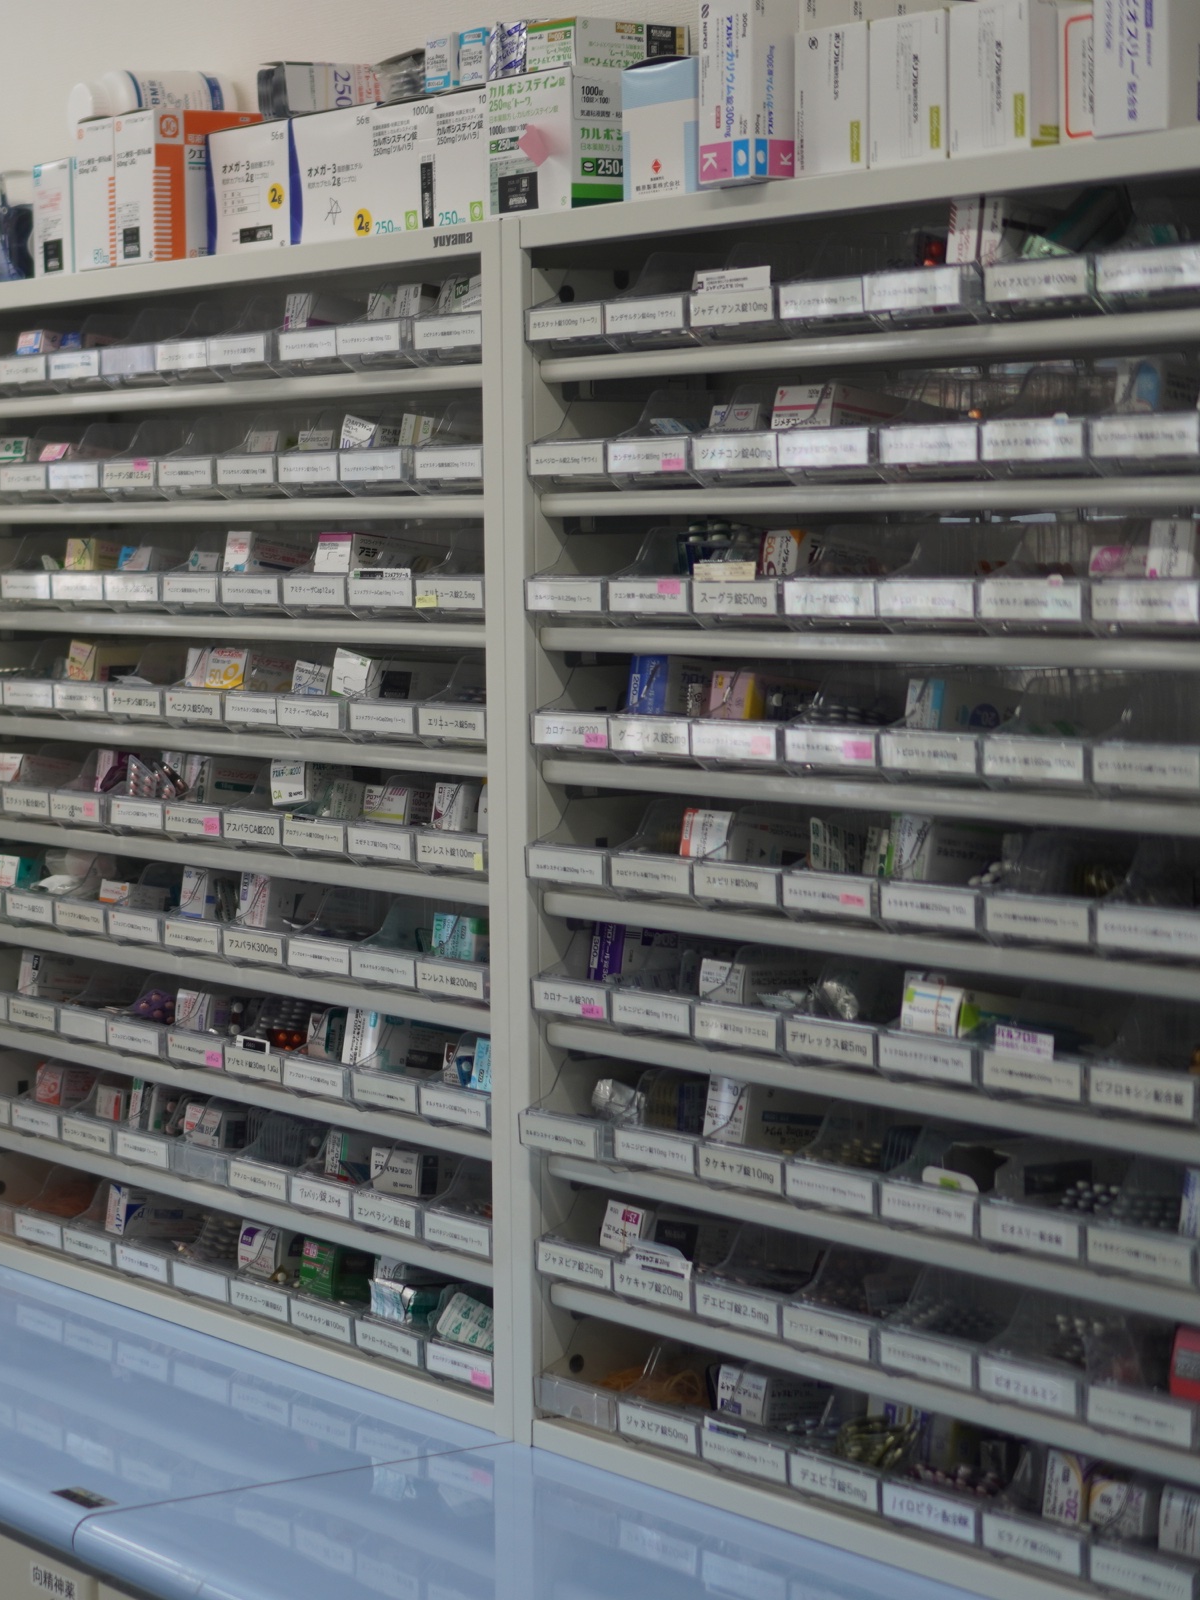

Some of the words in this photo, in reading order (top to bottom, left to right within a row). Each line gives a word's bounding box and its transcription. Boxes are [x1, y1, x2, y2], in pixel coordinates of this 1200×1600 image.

[490, 75, 566, 98] カルボシステイン錠
[581, 86, 603, 96] 1000錠
[413, 105, 434, 116] 1000錠
[436, 121, 484, 136] カルボシステイン錠
[373, 132, 418, 147] カルボシステイン錠
[703, 152, 717, 172] K
[780, 152, 792, 165] K
[270, 188, 282, 204] 2g
[357, 214, 370, 233] 2g
[433, 232, 473, 248] yuyama
[693, 302, 768, 316] ジャディアンス錠10mg
[701, 447, 772, 459] ジメチコン錠40mg
[701, 592, 767, 606] スーグラ錠50mg
[545, 726, 599, 735] カロナール錠200
[225, 822, 274, 836] アスパラCA錠200
[227, 938, 276, 956] アスパラK300mg
[420, 972, 477, 990] エンレスト錠200mg
[544, 991, 595, 1005] カロナール錠300
[790, 1032, 867, 1056] デザレックス錠5mg
[226, 1056, 280, 1074] アゾセミド錠30mg「JG」
[705, 1156, 774, 1184] タケキャブ錠10mg
[356, 1205, 411, 1229] エンペラシン配合錠
[544, 1251, 604, 1278] ジャヌビア錠25mg
[619, 1272, 684, 1301] タケキャブ錠20mg
[702, 1293, 769, 1323] デエビゴ錠2.5mg
[625, 1416, 689, 1444] ジャヌビア錠50mg
[800, 1468, 868, 1501] デエビゴ錠5mg
[33, 1566, 75, 1599] 向精神薬
